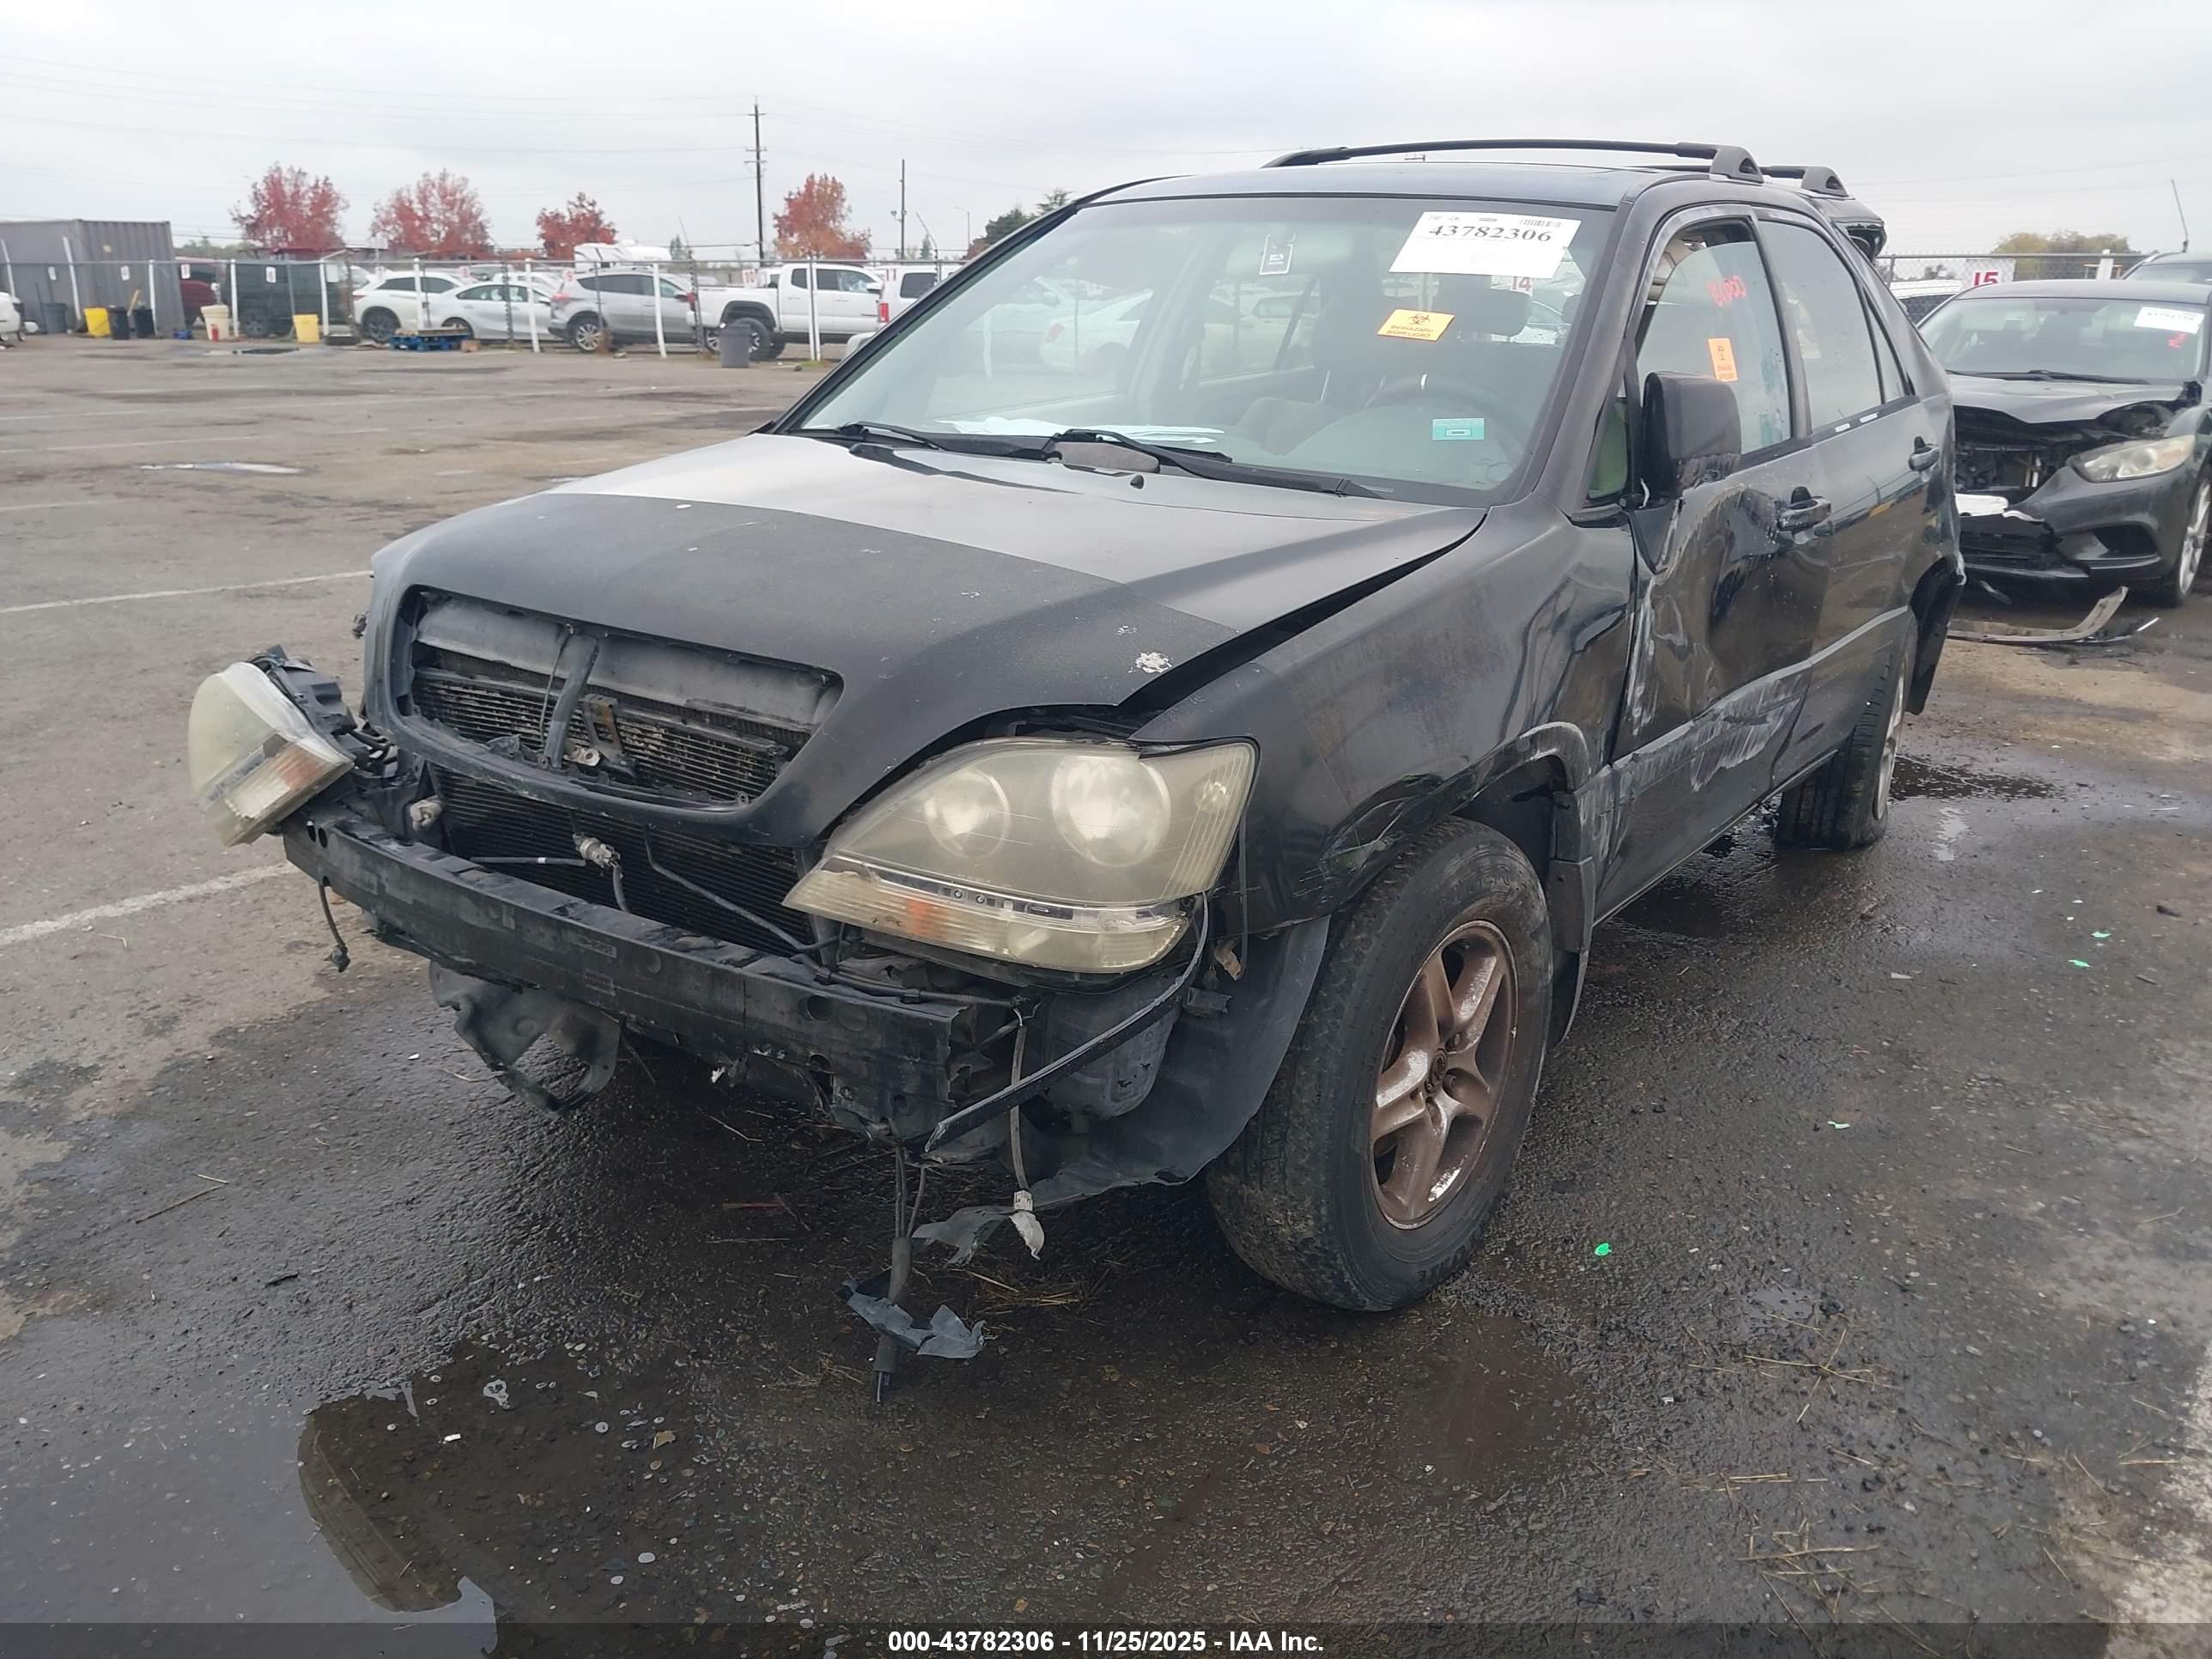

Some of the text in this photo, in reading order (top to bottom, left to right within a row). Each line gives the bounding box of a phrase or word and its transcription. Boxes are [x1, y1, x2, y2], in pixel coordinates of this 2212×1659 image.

[1428, 224, 1553, 241] 43782306
[1512, 276, 1532, 291] 14
[1974, 271, 1999, 286] 15
